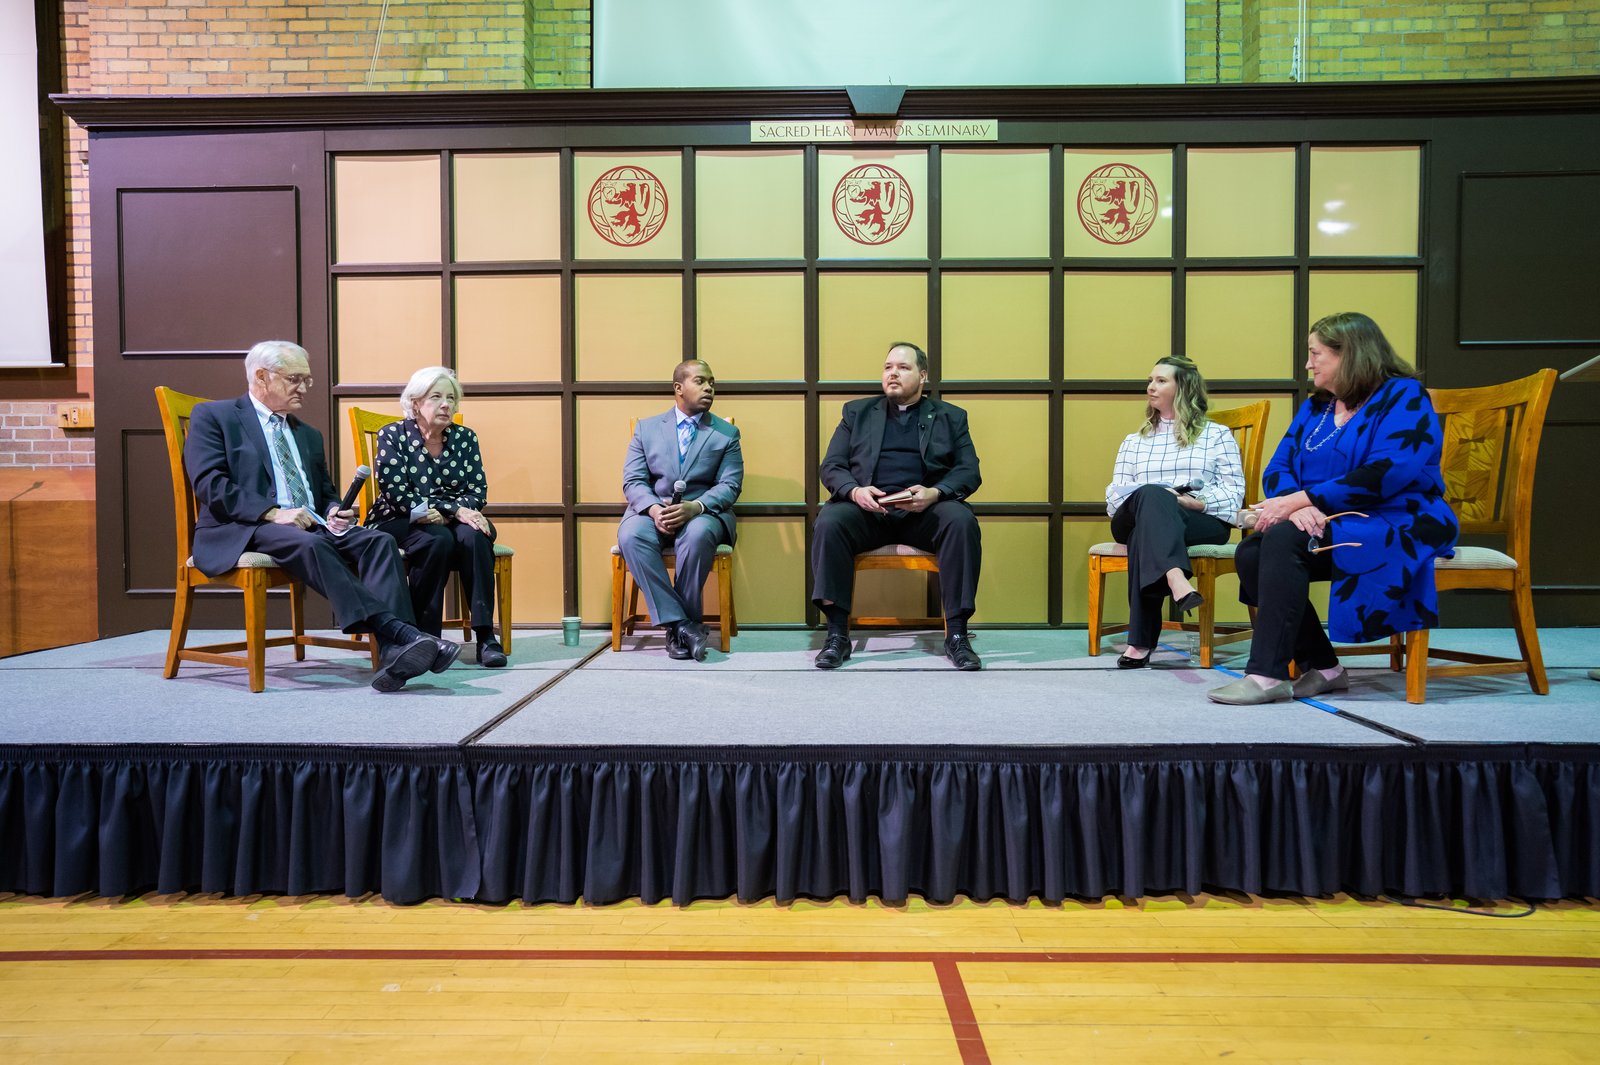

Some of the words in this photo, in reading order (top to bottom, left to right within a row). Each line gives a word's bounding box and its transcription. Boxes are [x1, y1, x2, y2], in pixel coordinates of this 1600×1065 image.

[759, 124, 810, 138] SACRED
[814, 124, 857, 137] HEART
[863, 124, 914, 138] MAJOR
[917, 123, 990, 137] SEMINARY
